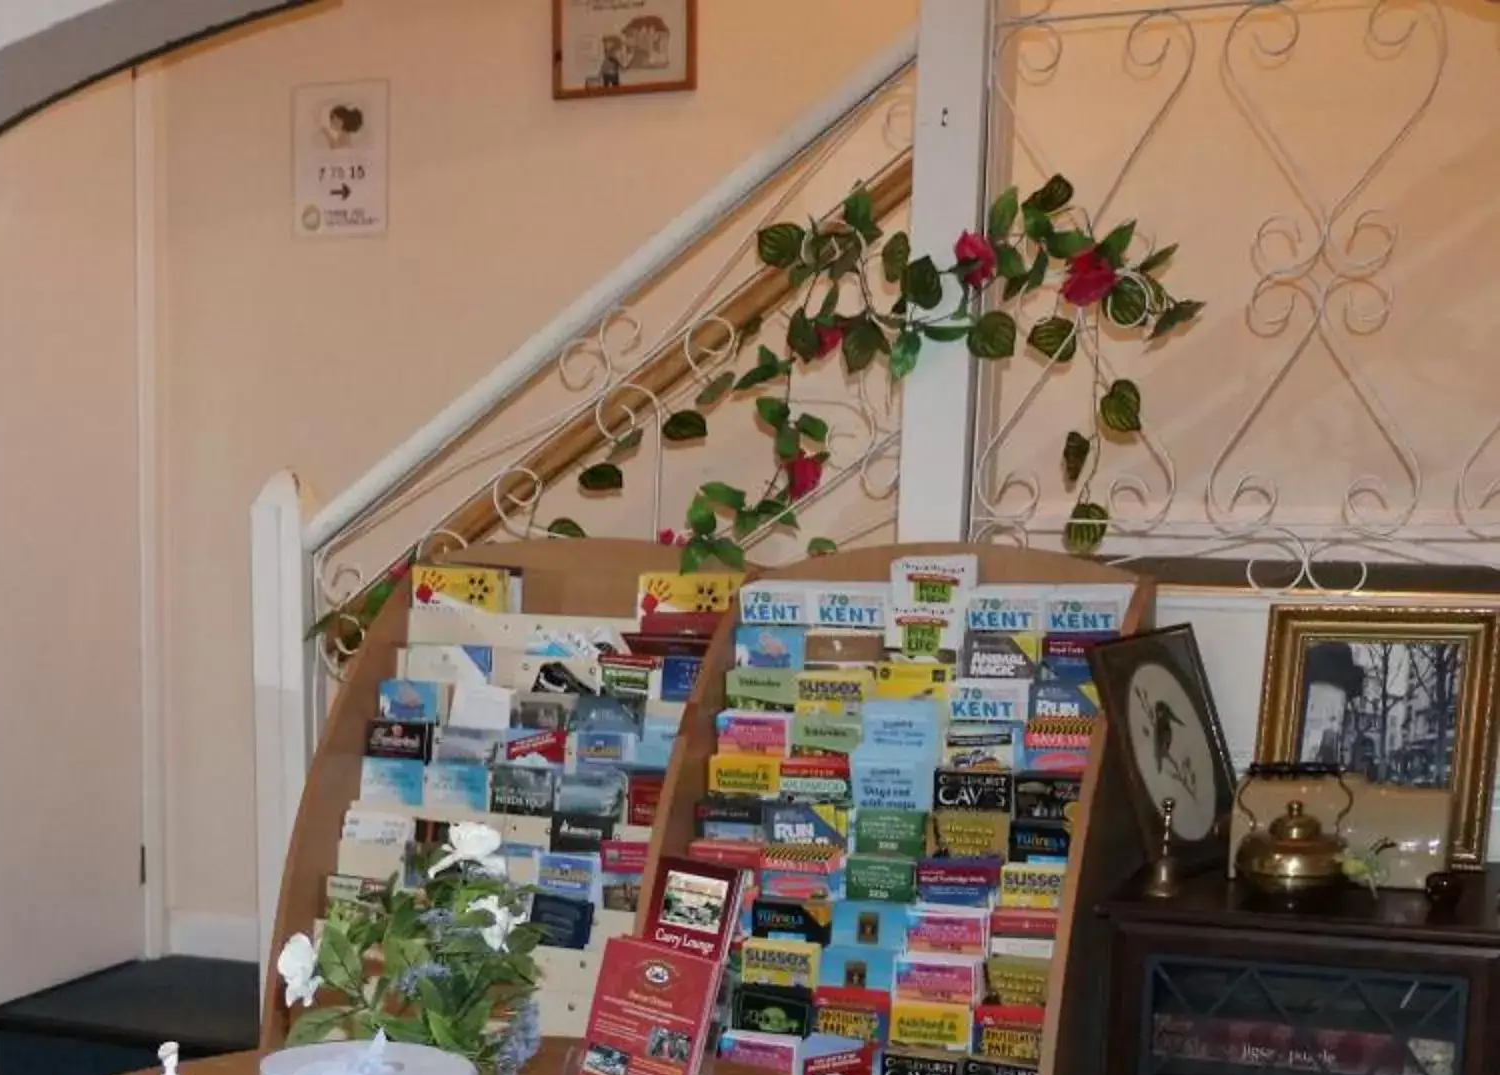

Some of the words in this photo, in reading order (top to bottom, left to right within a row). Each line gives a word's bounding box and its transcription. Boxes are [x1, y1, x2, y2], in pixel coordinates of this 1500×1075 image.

[743, 604, 800, 621] KENT
[819, 606, 879, 623] KENT
[970, 611, 1031, 627] KENT
[1051, 612, 1113, 629] KENT
[951, 701, 1013, 718] KENT
[773, 823, 814, 839] RUN
[682, 933, 715, 956] Lounge
